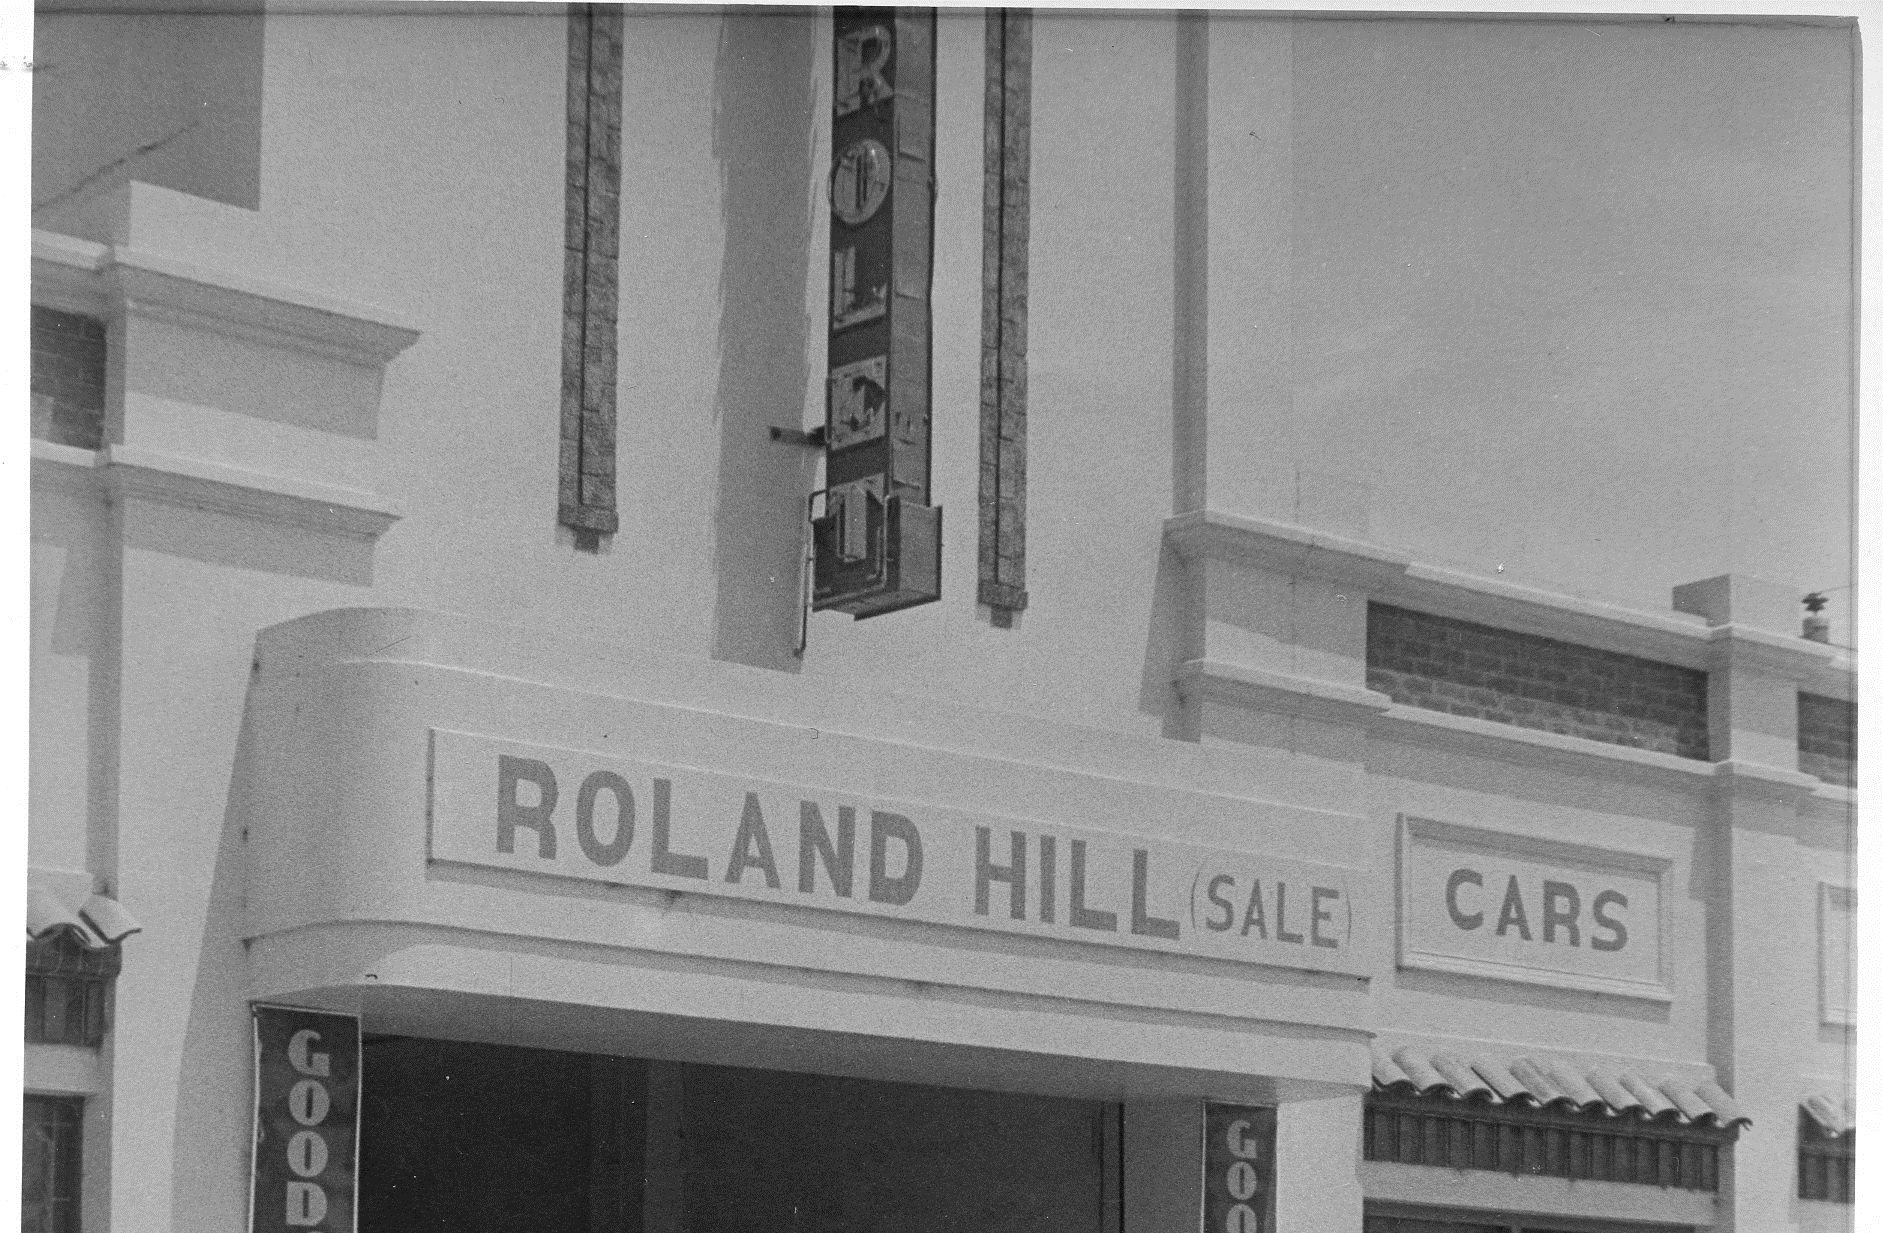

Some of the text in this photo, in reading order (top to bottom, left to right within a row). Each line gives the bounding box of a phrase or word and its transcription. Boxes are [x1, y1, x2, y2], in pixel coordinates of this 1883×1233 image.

[494, 754, 1353, 950] ROLAND HILL (SALE)
[1445, 868, 1629, 952] CARS
